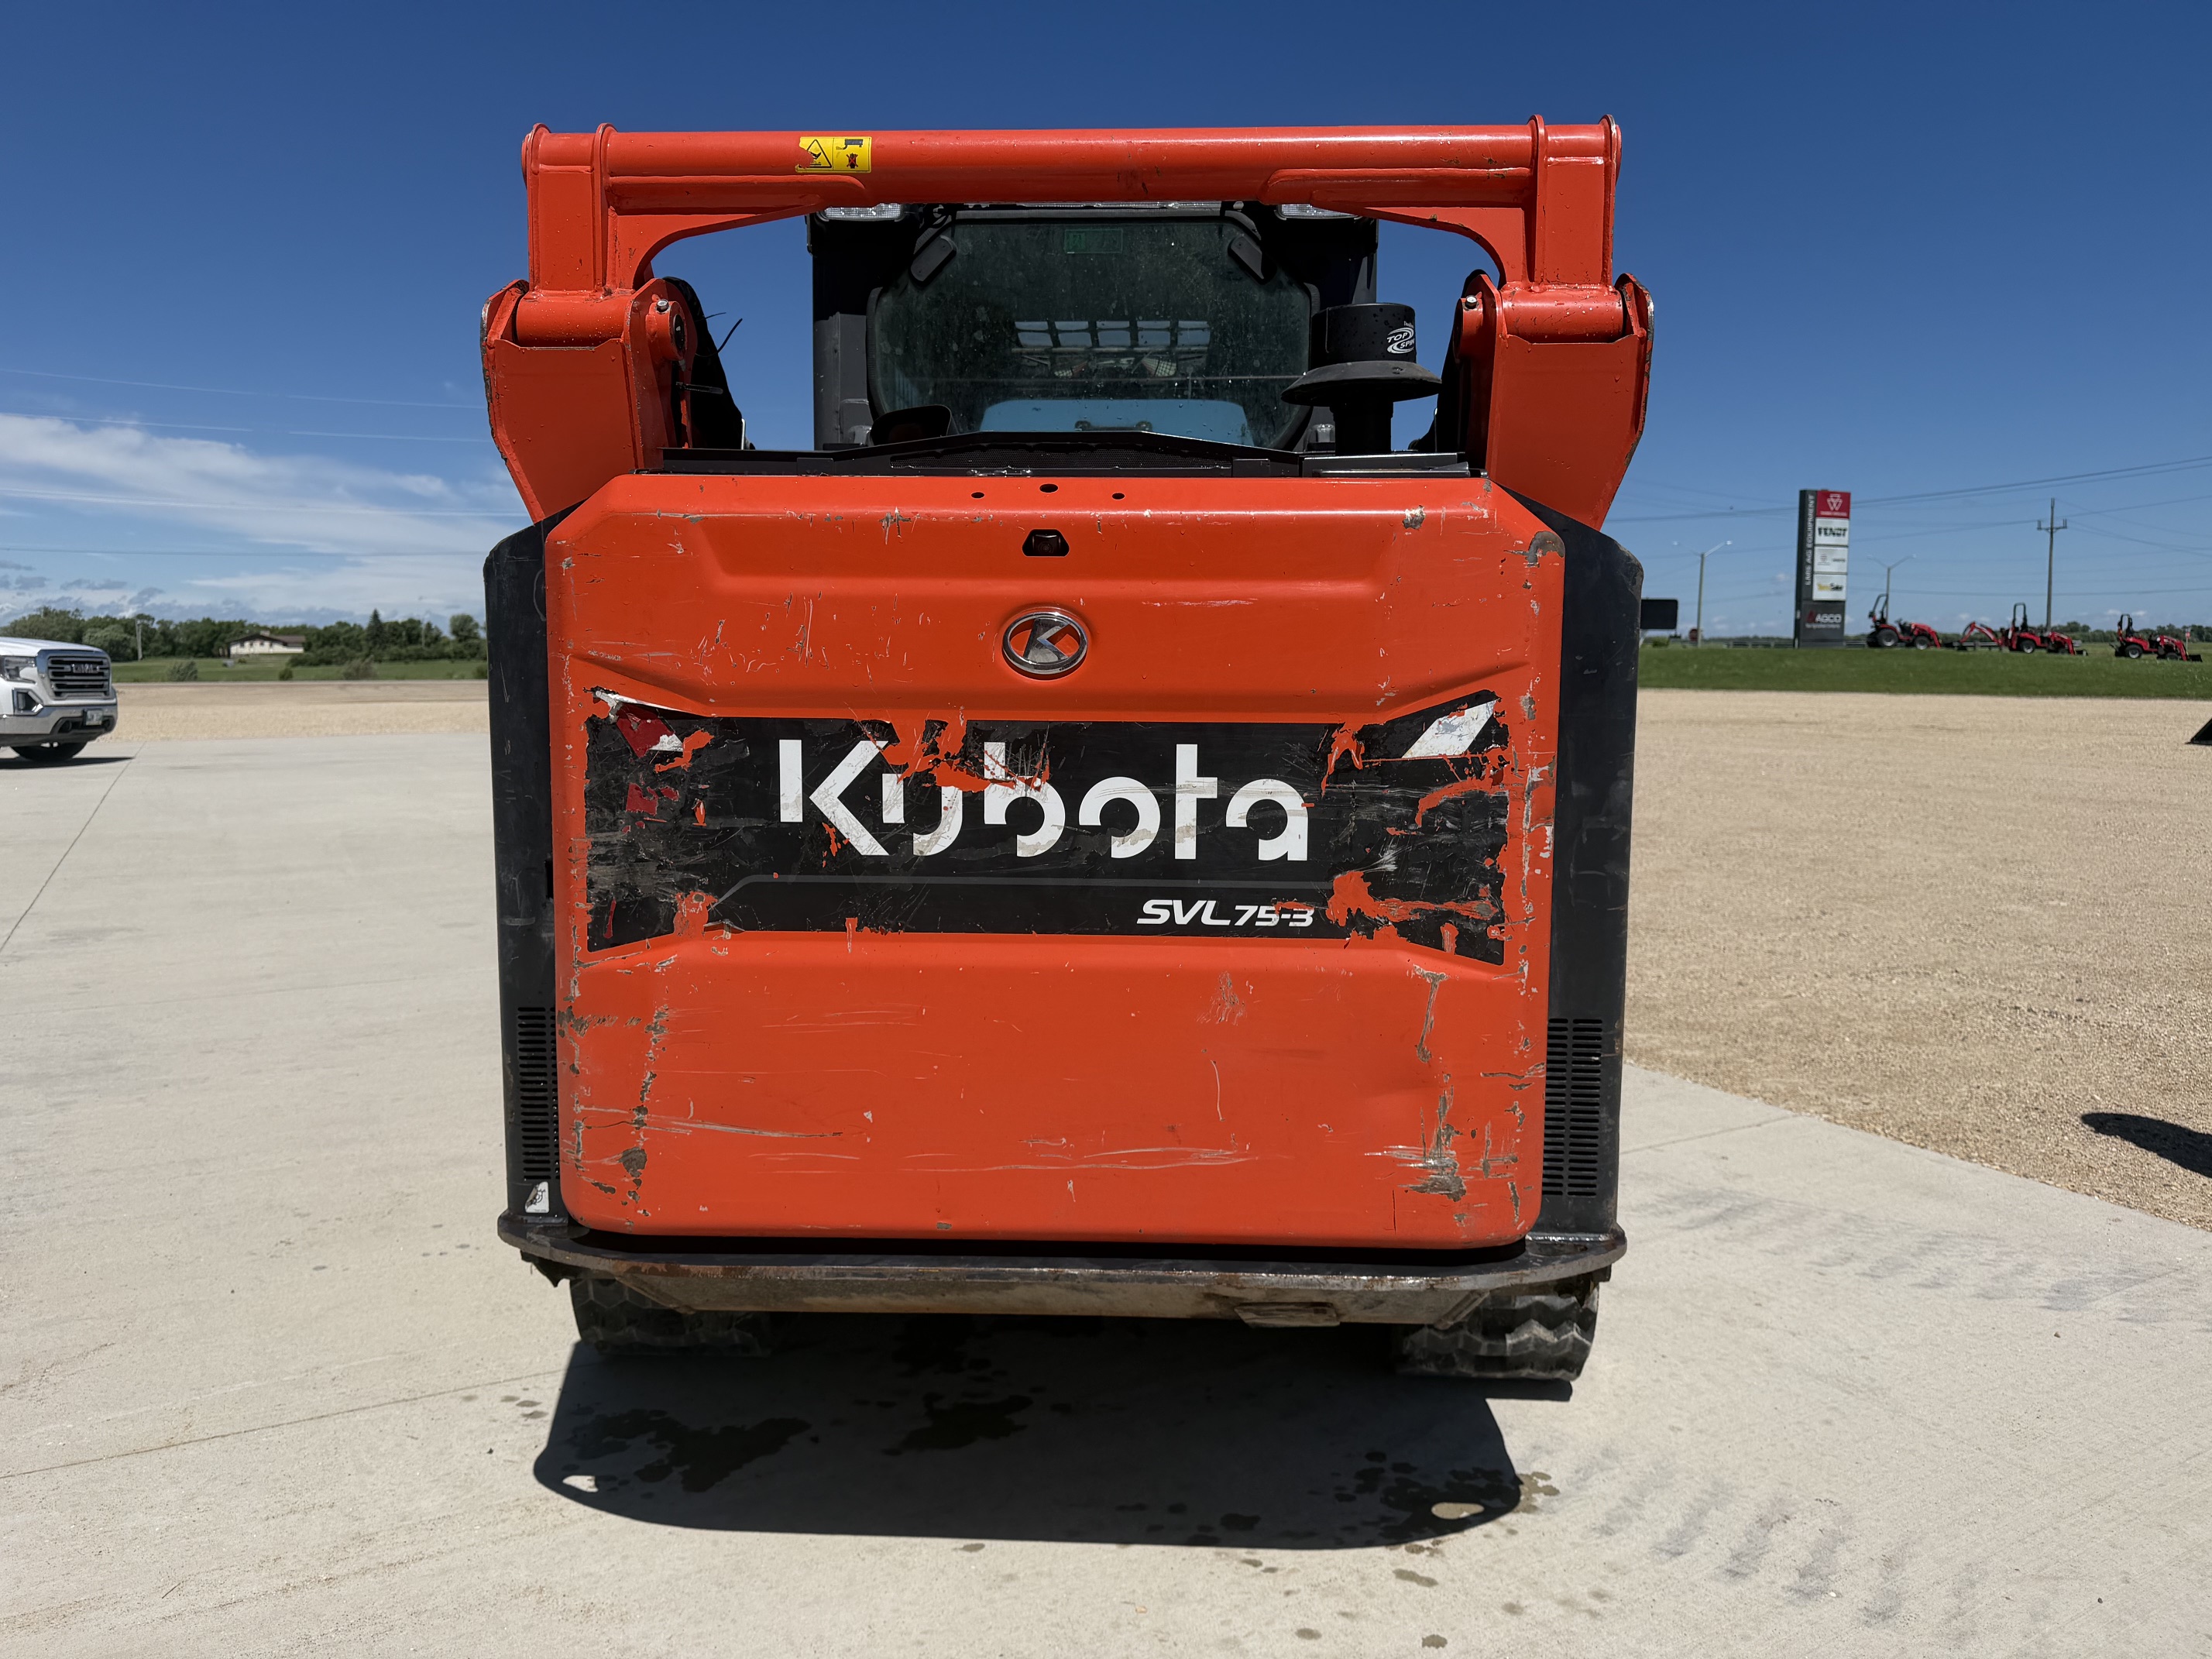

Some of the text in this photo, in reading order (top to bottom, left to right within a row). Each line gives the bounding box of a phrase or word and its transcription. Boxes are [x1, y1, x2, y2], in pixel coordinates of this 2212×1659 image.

[1387, 332, 1408, 343] TOP
[1806, 494, 1815, 548] EQUIPMENT
[1805, 549, 1813, 564] AG
[1815, 613, 1842, 623] AGCO
[778, 738, 1309, 861] Kubota
[1136, 899, 1315, 927] SVL 75-3
